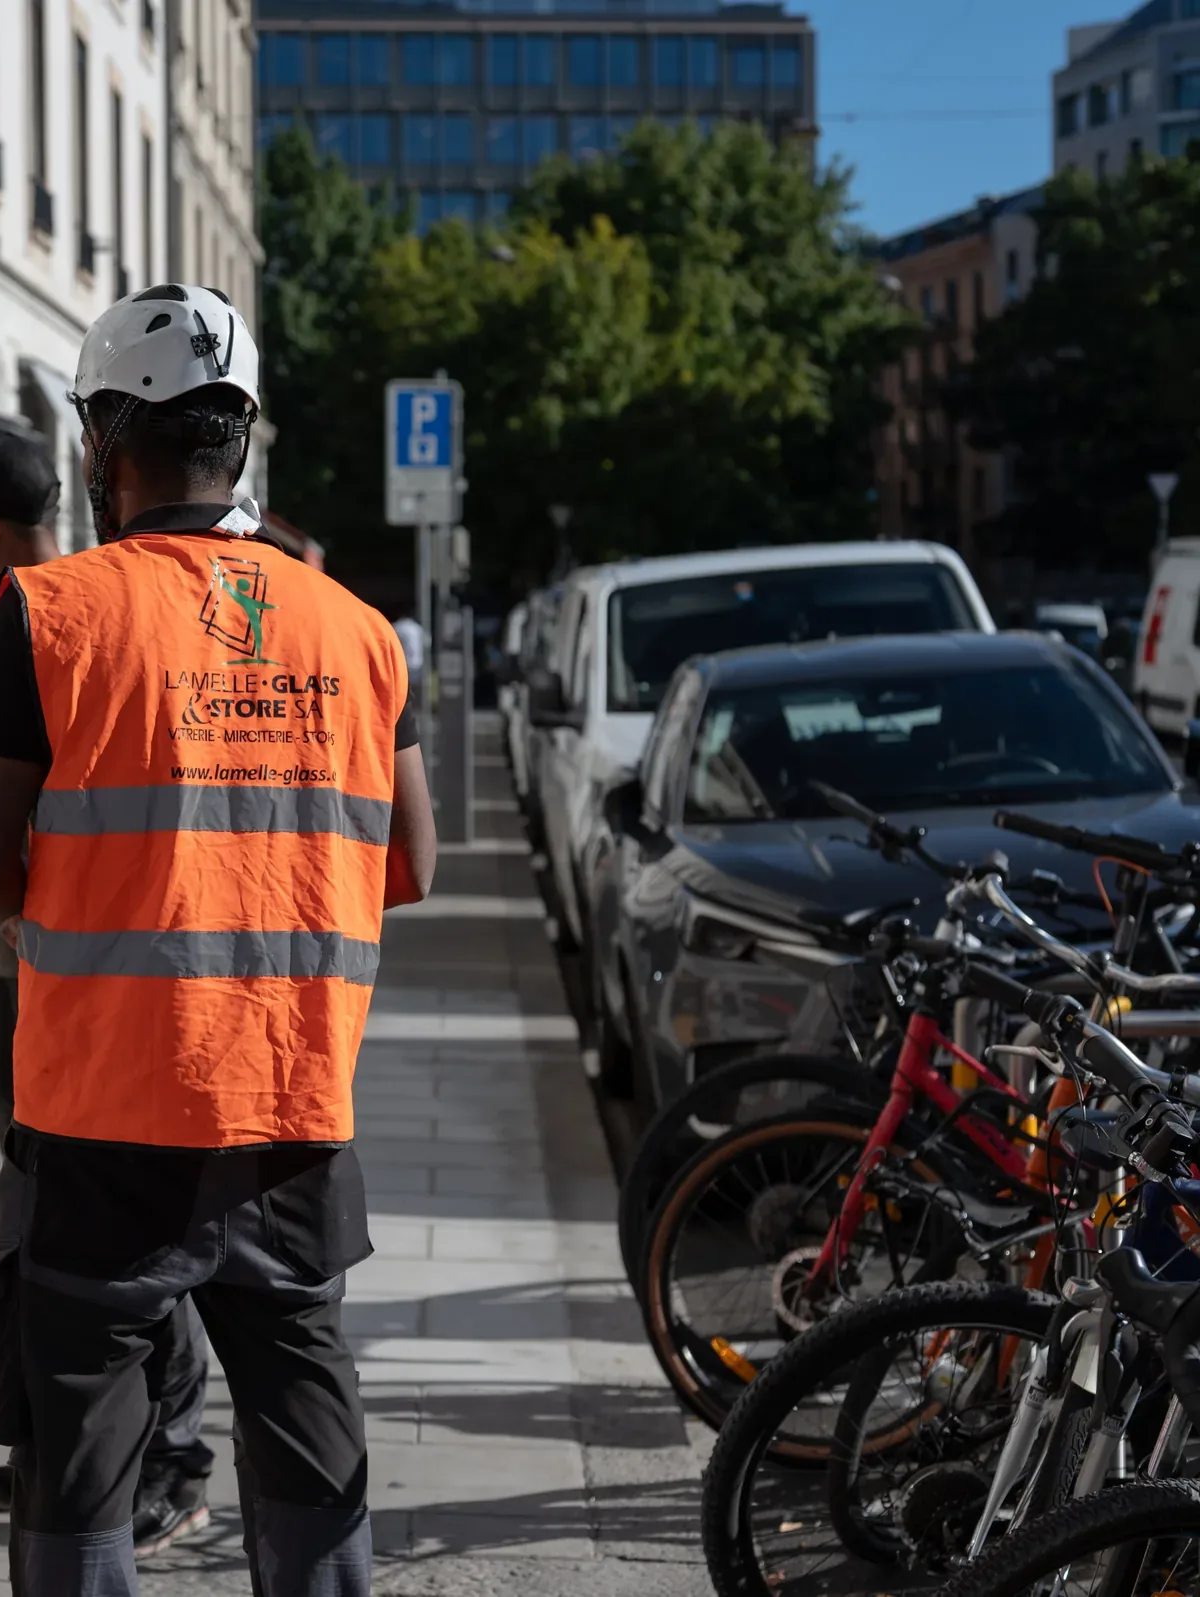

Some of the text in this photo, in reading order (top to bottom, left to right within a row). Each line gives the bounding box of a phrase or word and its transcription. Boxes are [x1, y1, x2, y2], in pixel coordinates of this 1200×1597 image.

[411, 394, 438, 435] P
[271, 674, 340, 697] GLASS
[294, 699, 324, 719] SA
[168, 727, 215, 742] VITRERIE
